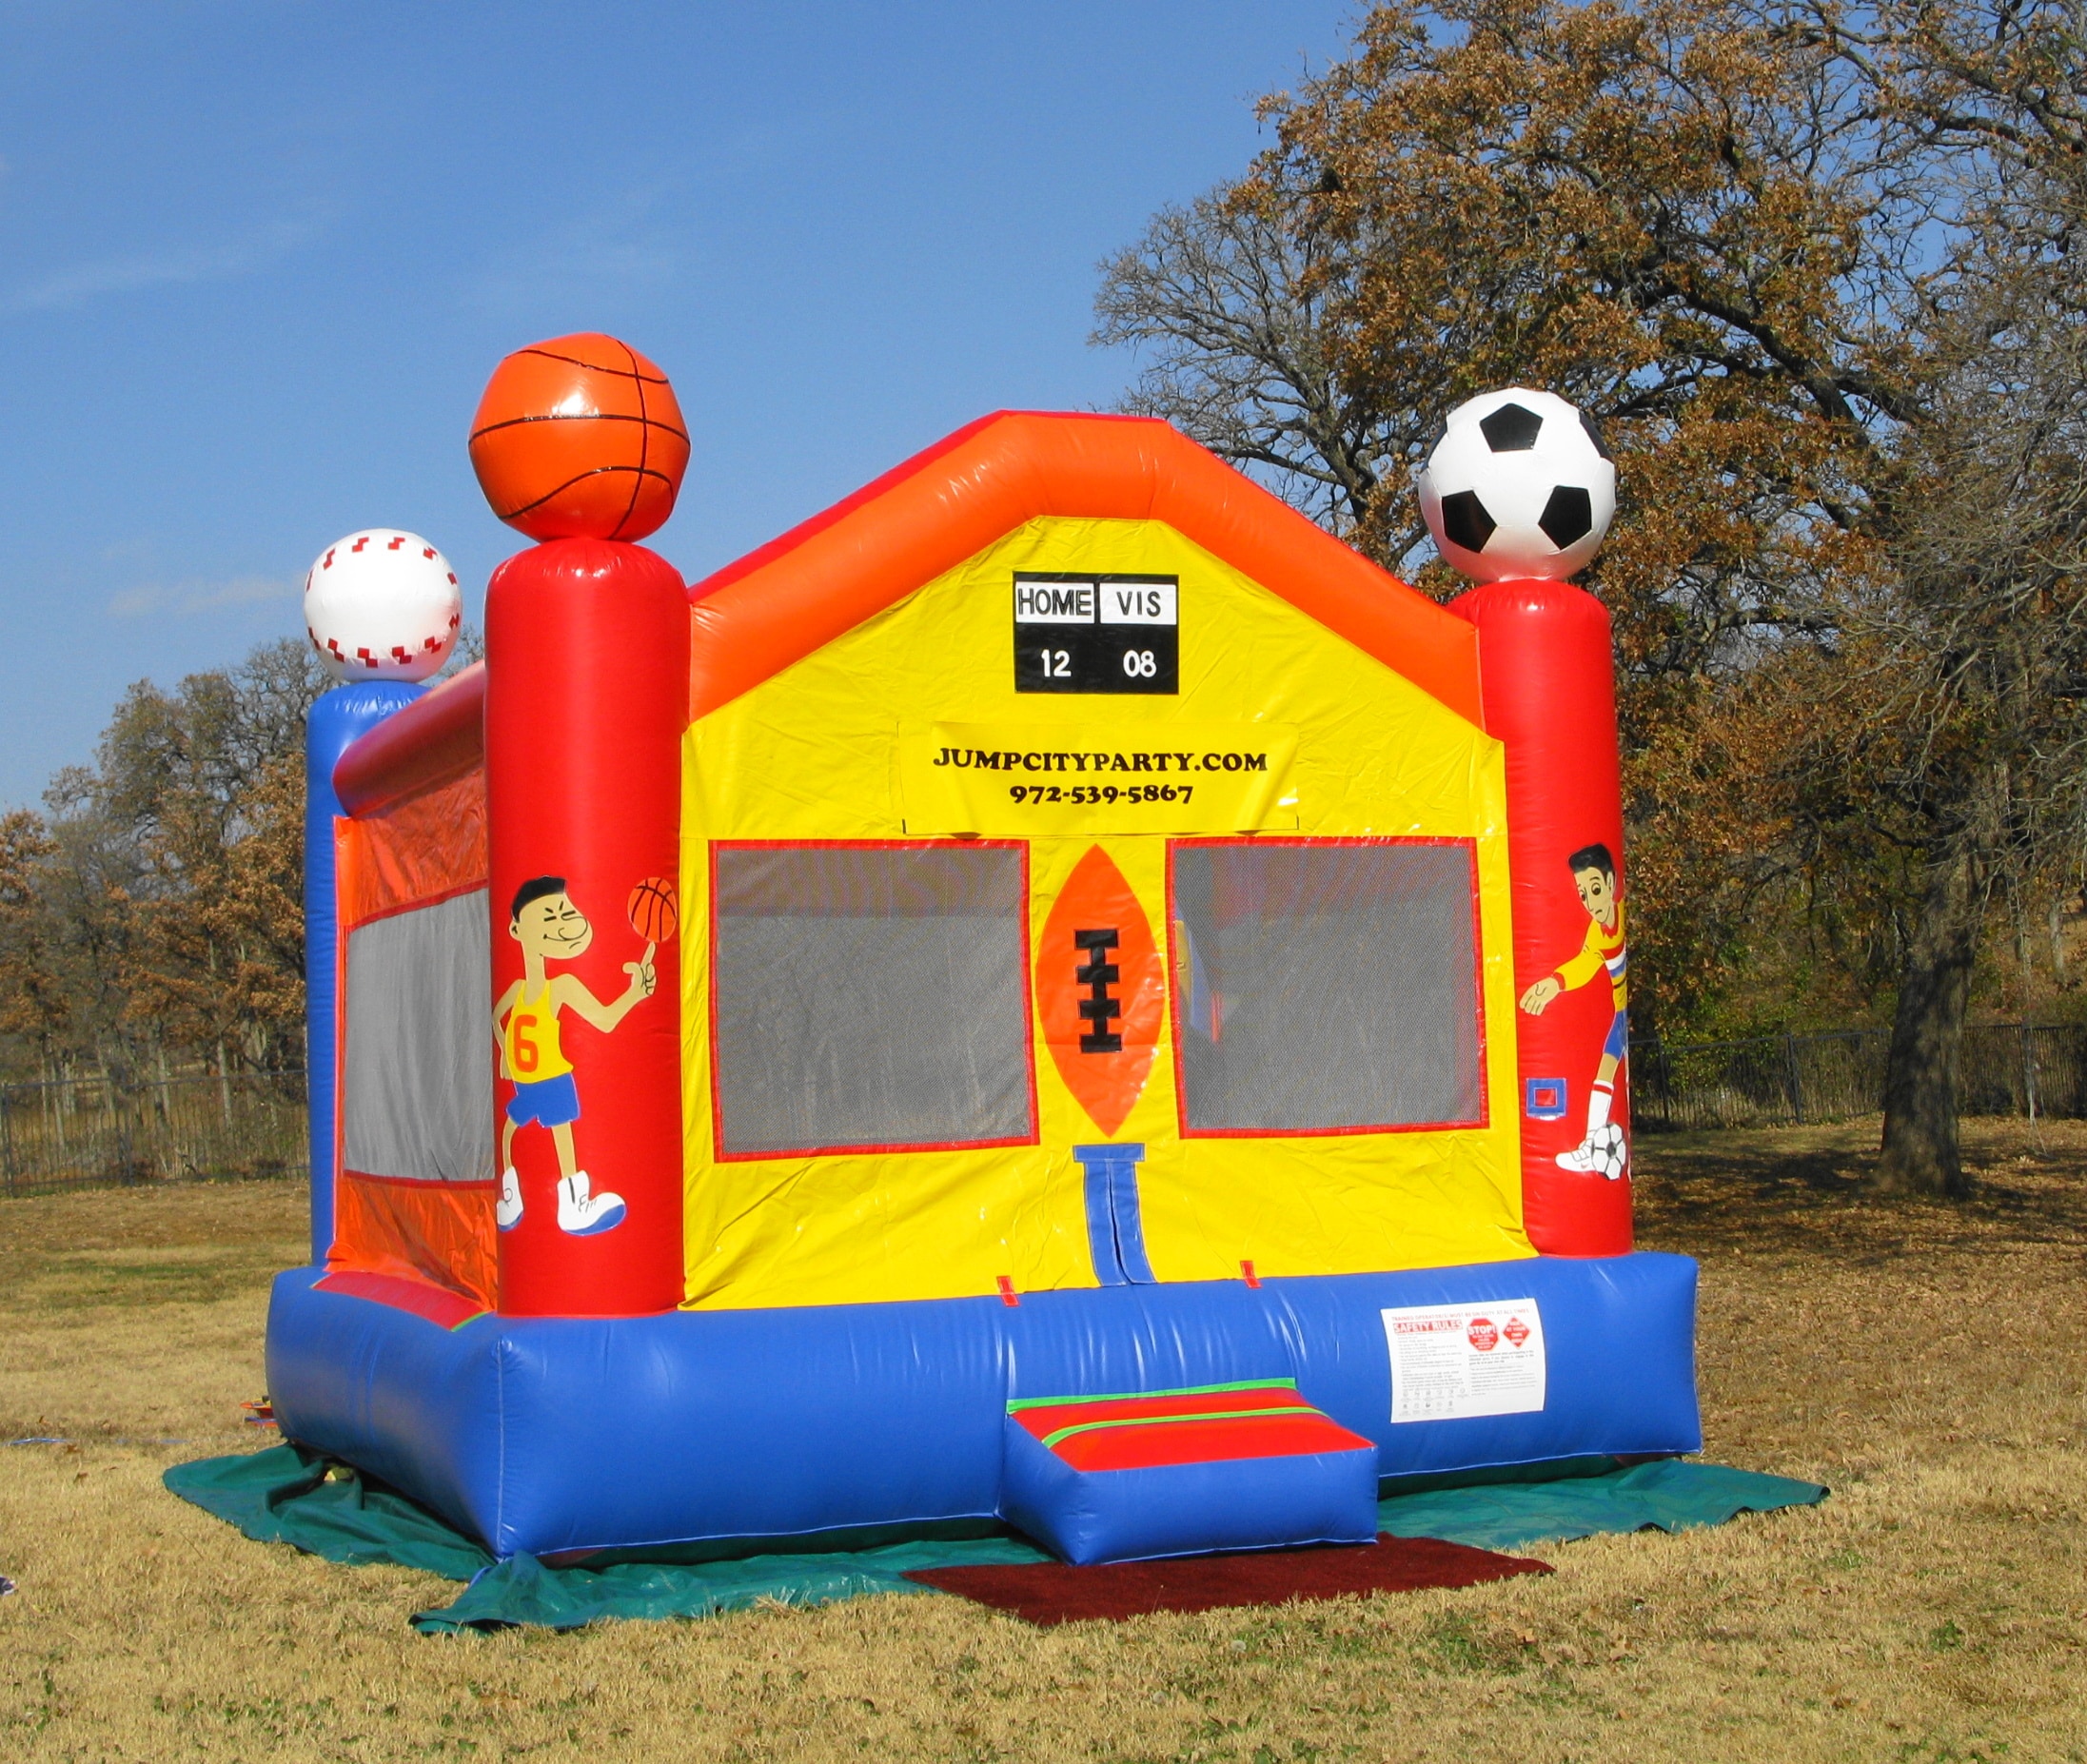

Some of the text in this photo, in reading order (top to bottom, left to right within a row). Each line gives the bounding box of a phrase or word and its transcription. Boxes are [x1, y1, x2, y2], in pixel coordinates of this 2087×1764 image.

[1017, 588, 1161, 617] HOME VIS
[1041, 649, 1157, 678] 12 08
[933, 747, 1268, 772] JUMPCITYPARTY.COM
[1009, 784, 1193, 805] 972-539-5867
[514, 1013, 539, 1073] 6
[1393, 1320, 1463, 1333] SAFETY RULES
[1467, 1324, 1497, 1335] STOP!
